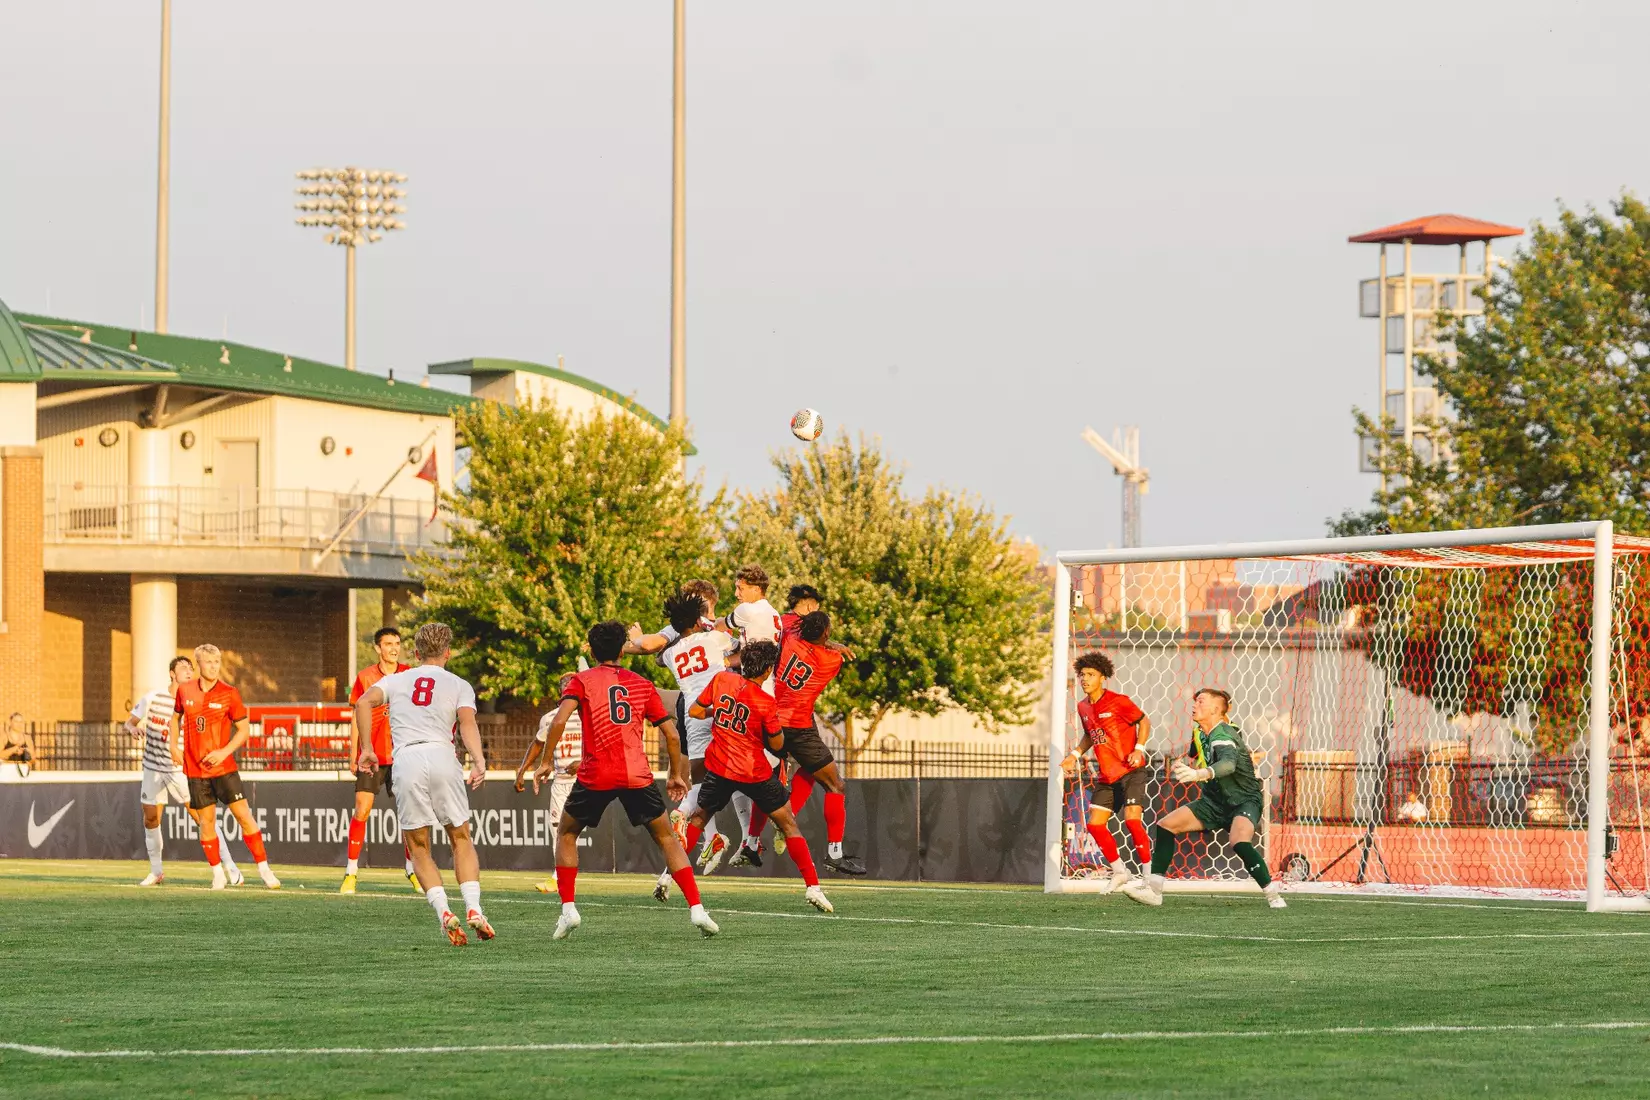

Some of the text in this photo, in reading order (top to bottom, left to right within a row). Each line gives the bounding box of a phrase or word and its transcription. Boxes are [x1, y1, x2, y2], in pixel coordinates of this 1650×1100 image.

[675, 645, 710, 679] 23
[780, 653, 813, 691] 13
[411, 676, 436, 707] 8
[608, 685, 632, 725] 6
[196, 716, 206, 732] 9
[714, 693, 751, 735] 28
[559, 743, 573, 759] 17
[565, 732, 581, 742] STAT
[165, 806, 199, 840] THE
[276, 808, 310, 842] THE
[314, 808, 403, 844] TRATIO
